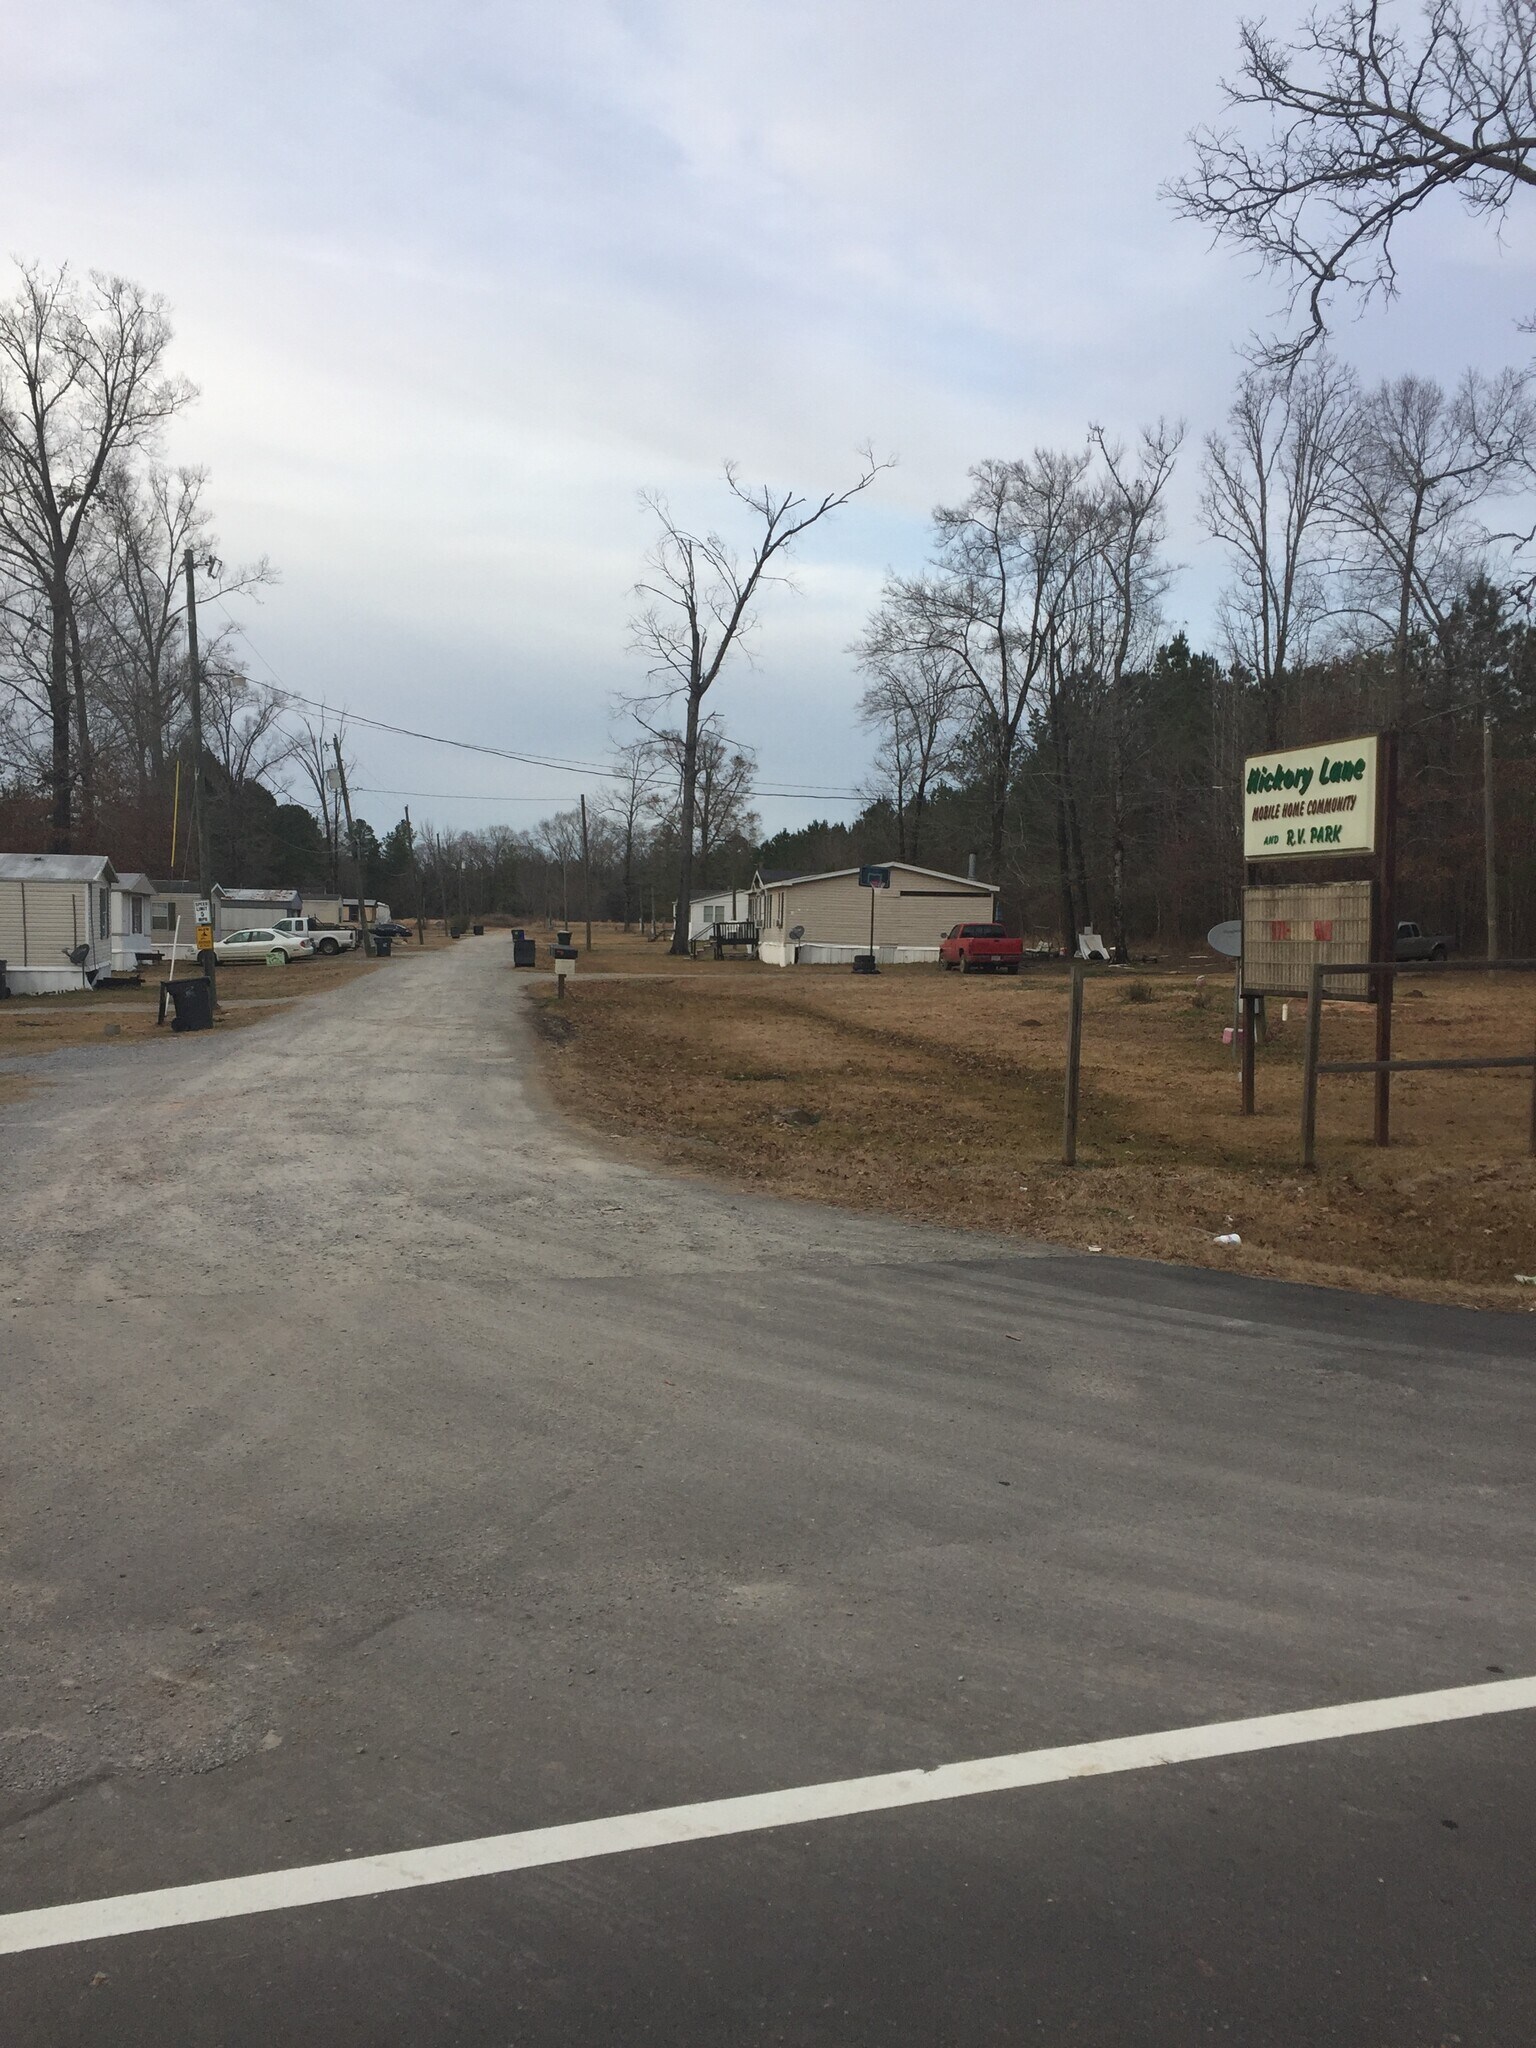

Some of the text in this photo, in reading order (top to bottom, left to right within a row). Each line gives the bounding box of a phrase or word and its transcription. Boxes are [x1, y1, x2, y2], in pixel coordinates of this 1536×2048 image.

[1319, 756, 1366, 785] Lane
[1252, 795, 1357, 822] MOBILE HOME COMMUNITY
[1263, 824, 1343, 846] AND R.V. PARK
